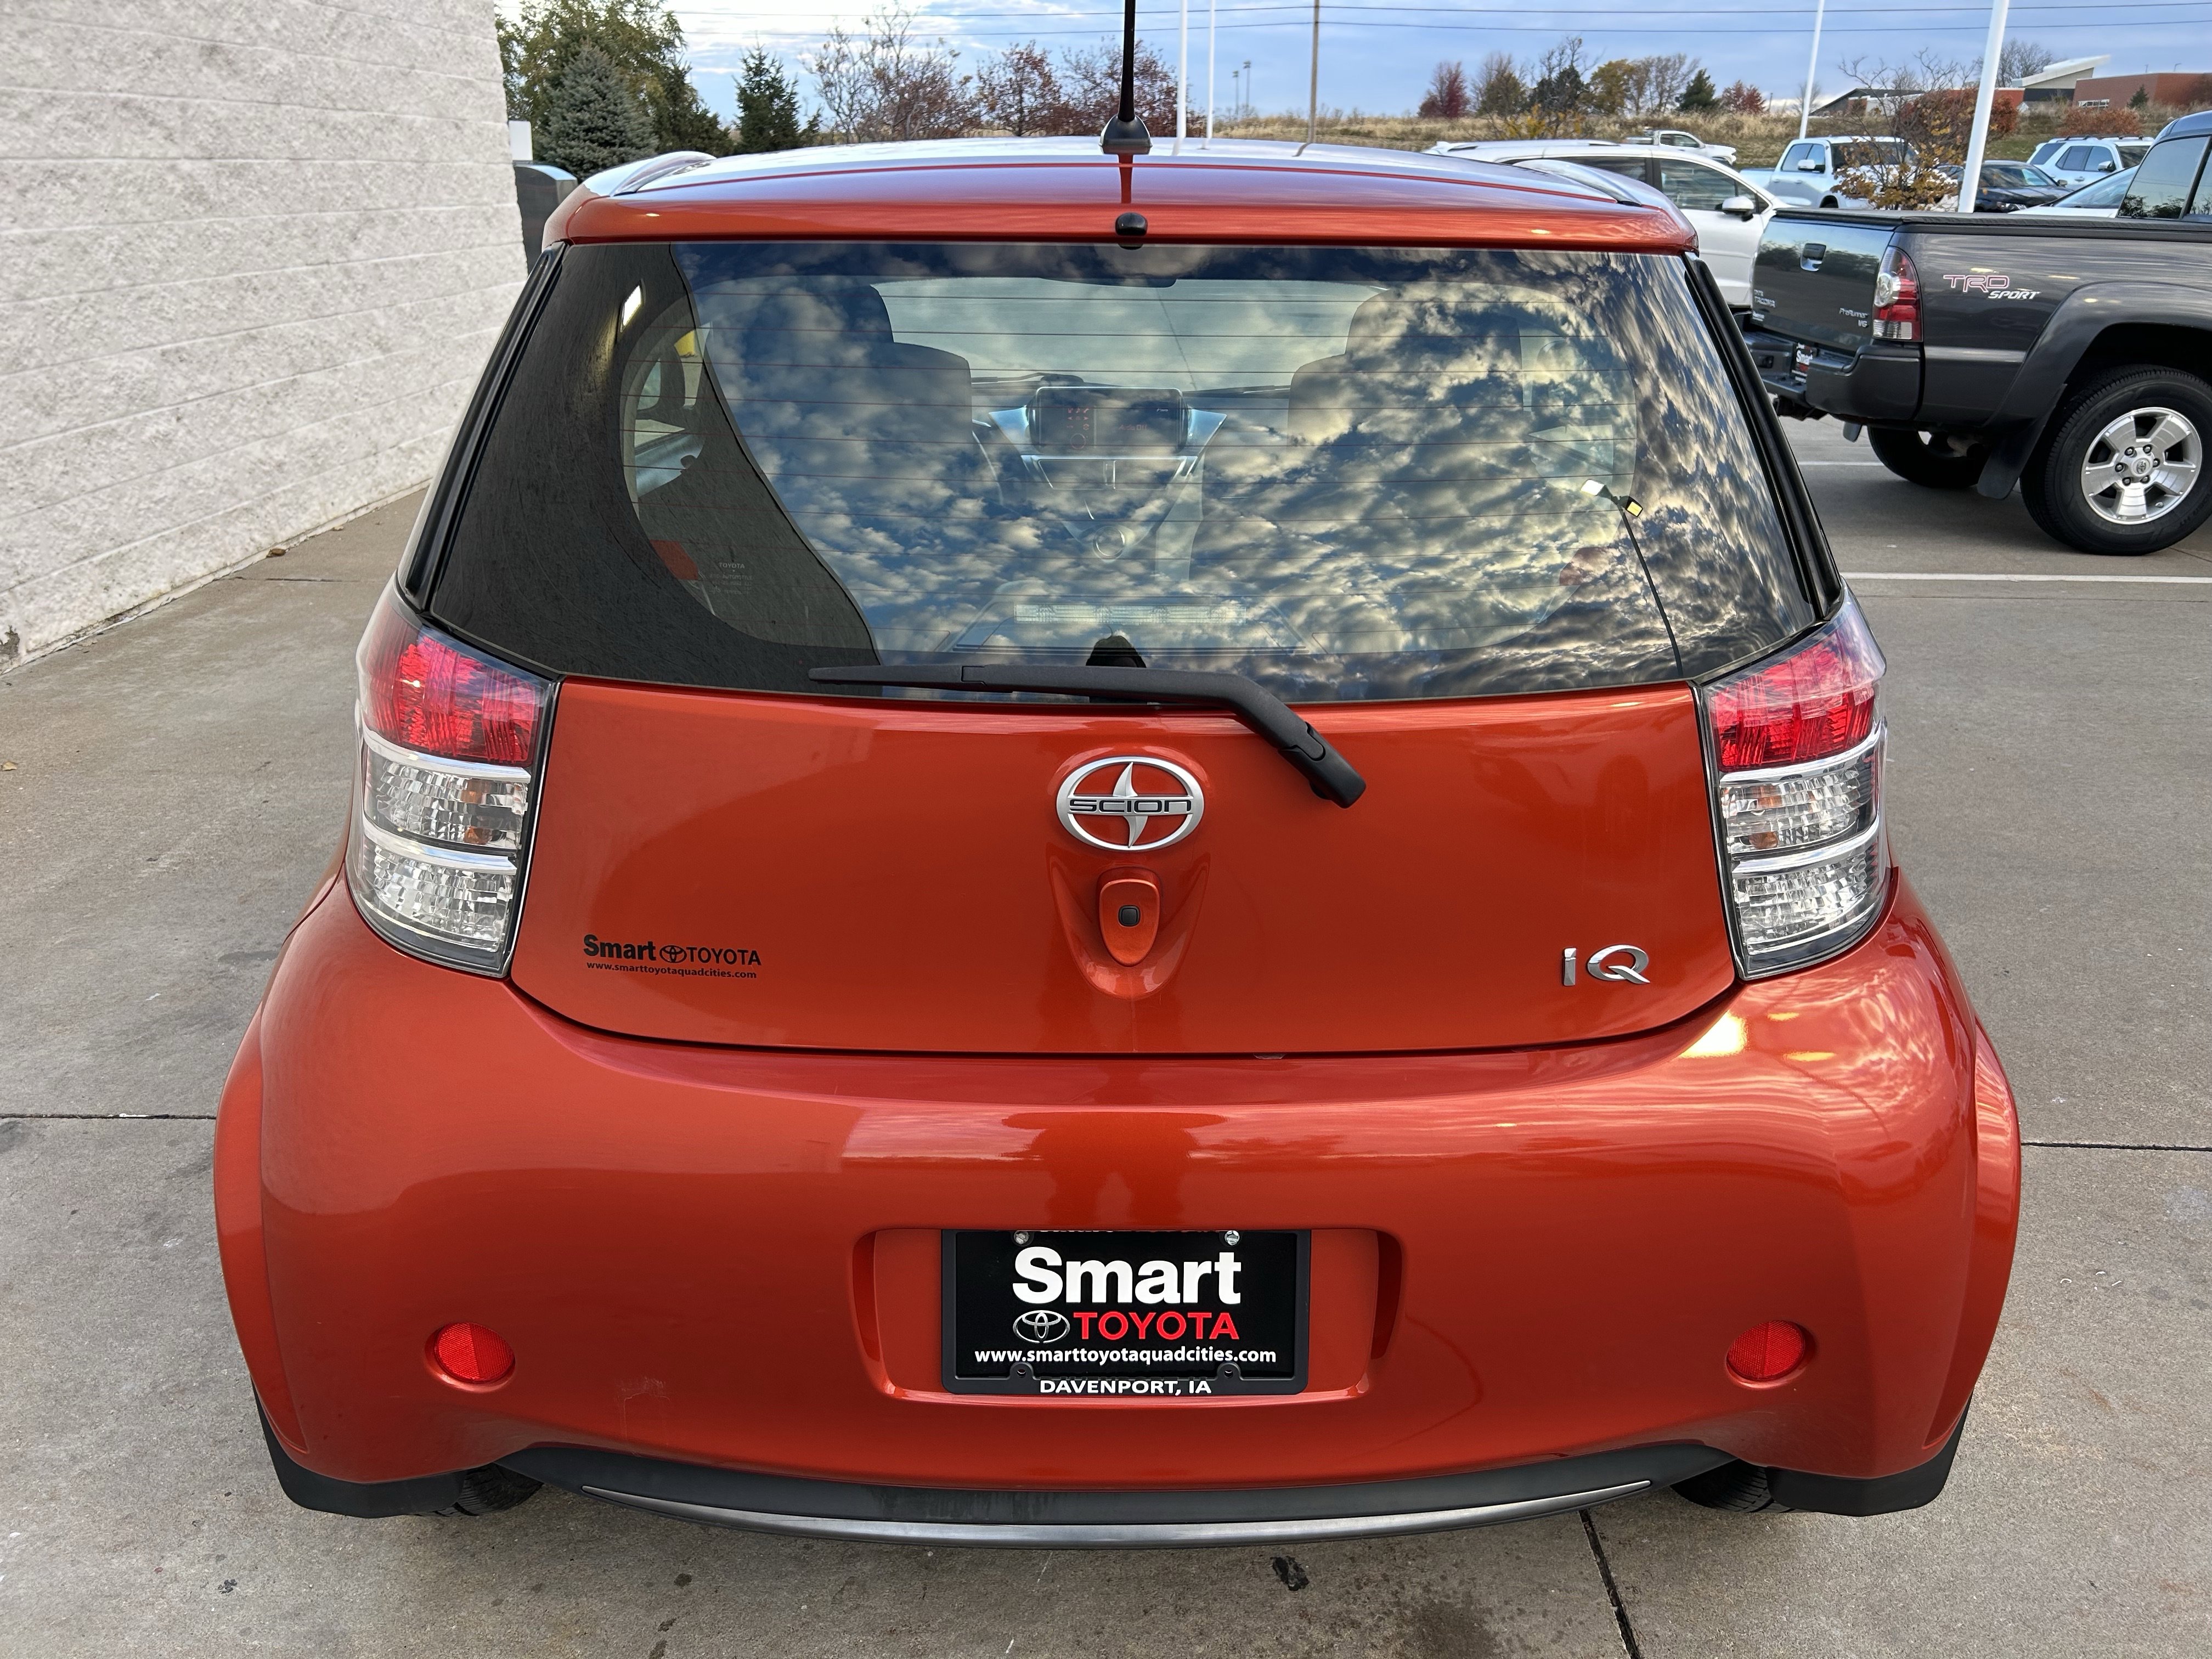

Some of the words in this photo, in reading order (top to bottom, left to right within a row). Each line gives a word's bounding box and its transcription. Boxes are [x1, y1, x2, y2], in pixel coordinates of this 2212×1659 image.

[1943, 274, 2010, 293] TRD
[1988, 290, 2041, 300] SPORT
[1069, 799, 1192, 813] SCION
[583, 934, 656, 961] Smart
[686, 946, 762, 966] TOYOTA
[586, 961, 757, 979] www.smarttoyotaquadcities.com
[1012, 1246, 1242, 1305] Smart
[1073, 1311, 1240, 1340] TOYOTA
[974, 1346, 1277, 1366] www.smarttoyotaquadcities.com
[1040, 1380, 1182, 1396] DAVENPORT,
[1189, 1380, 1212, 1393] IA
